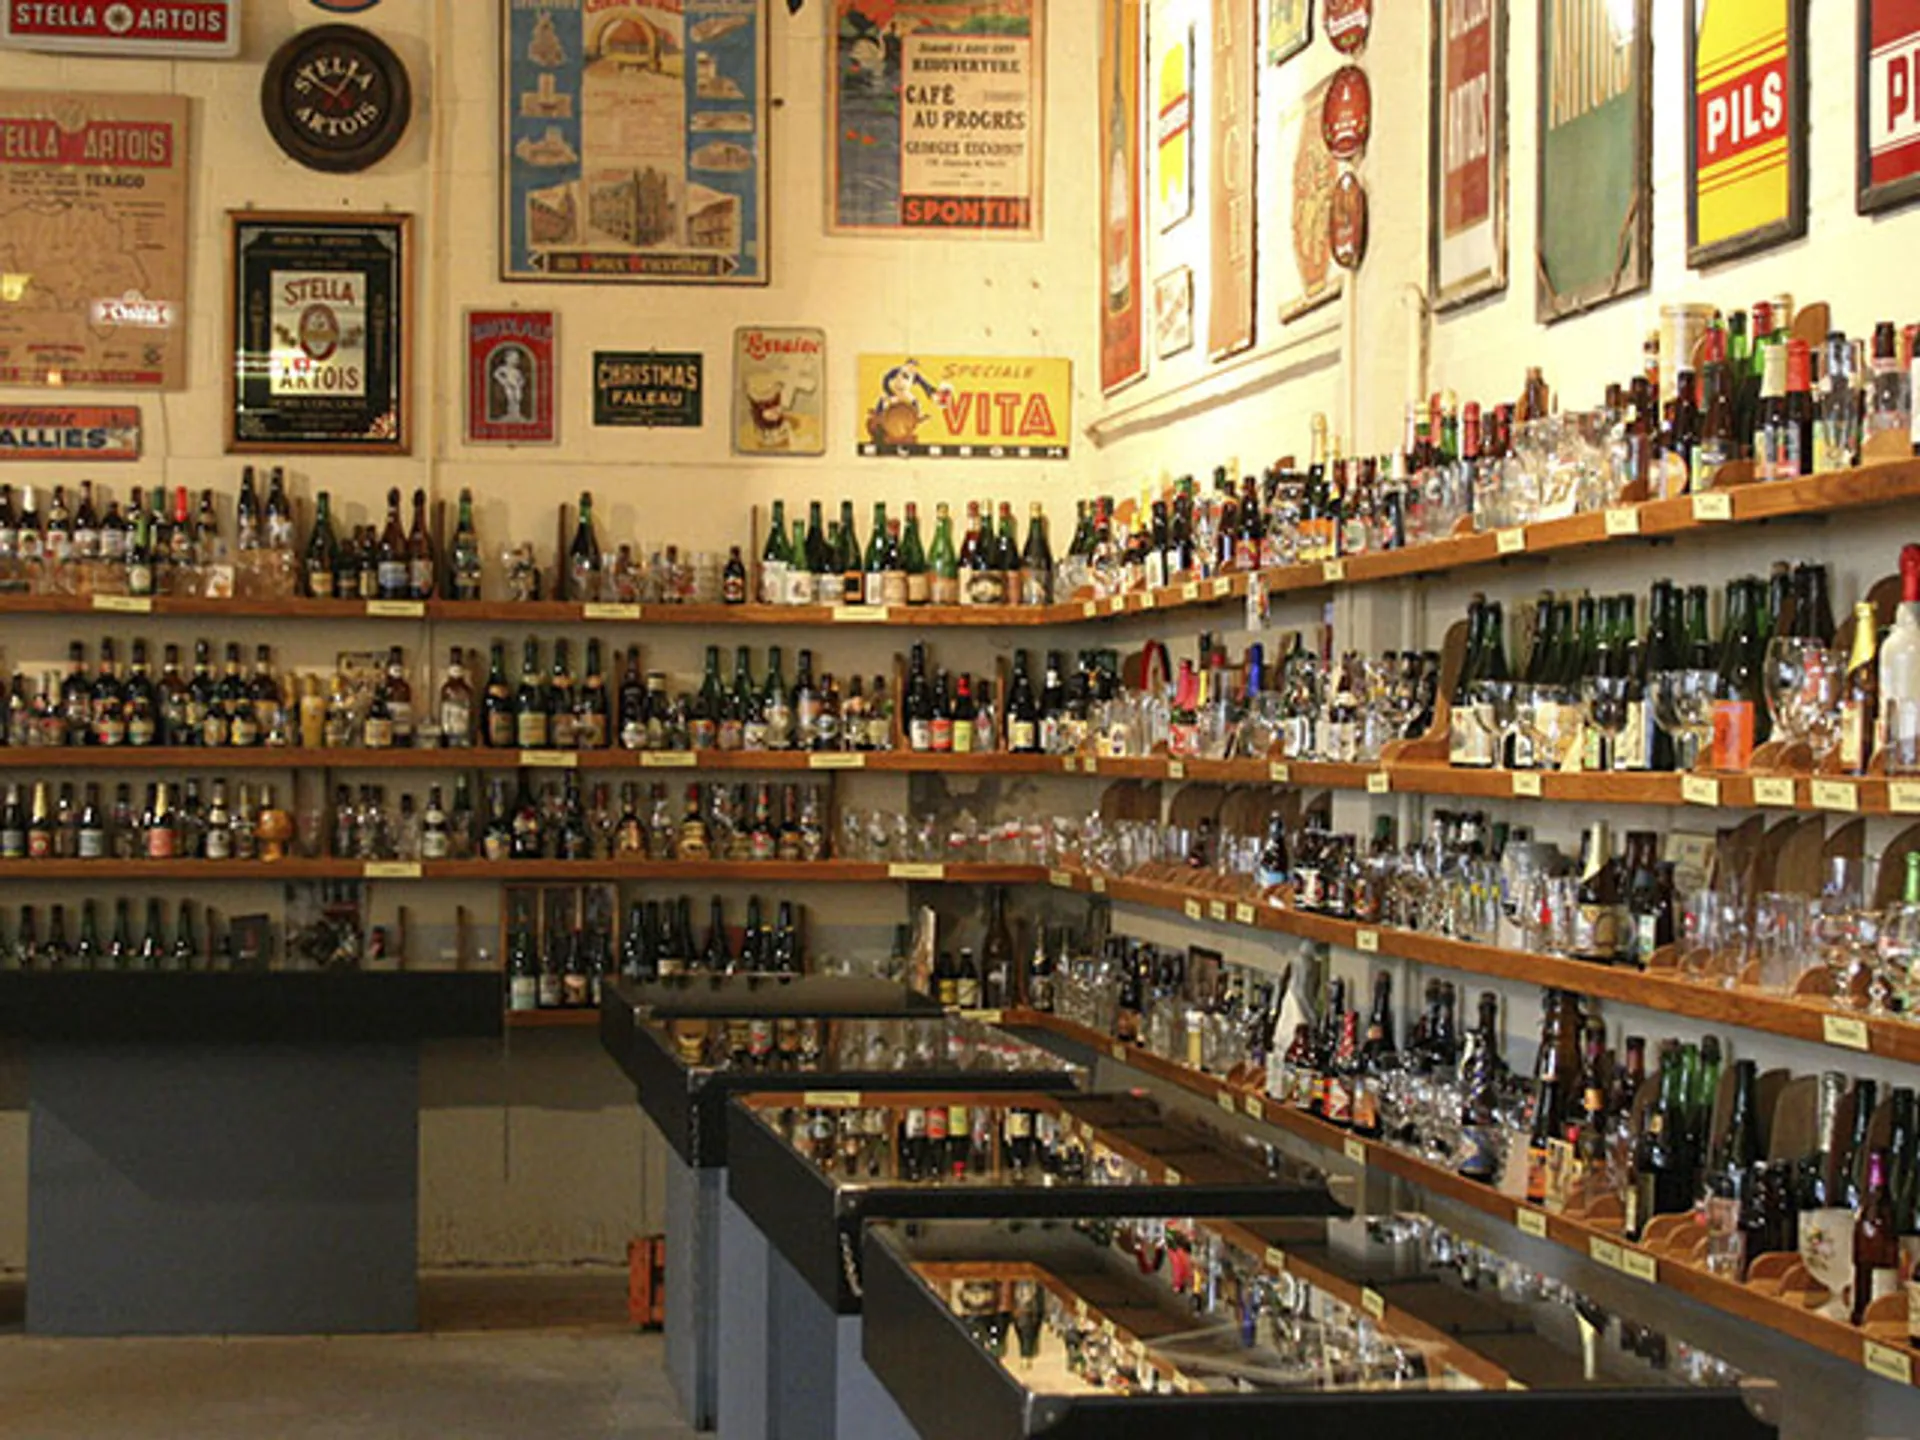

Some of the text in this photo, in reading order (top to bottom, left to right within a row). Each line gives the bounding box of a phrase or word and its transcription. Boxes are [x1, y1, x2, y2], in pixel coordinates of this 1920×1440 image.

[17, 3, 222, 31] STELLA ARTOIS
[294, 56, 376, 94] STELLA
[295, 102, 380, 137] ARTOIS
[912, 111, 939, 129] AU
[1706, 71, 1783, 154] PILS
[0, 125, 167, 161] ELLA ARTOIS
[905, 199, 1027, 227] SPONTIN
[284, 278, 355, 306] STELLA
[279, 366, 359, 391] ARTOIS
[599, 363, 698, 391] CHRISTMAS
[941, 361, 1035, 380] SPECIALE
[941, 392, 1057, 437] VITA
